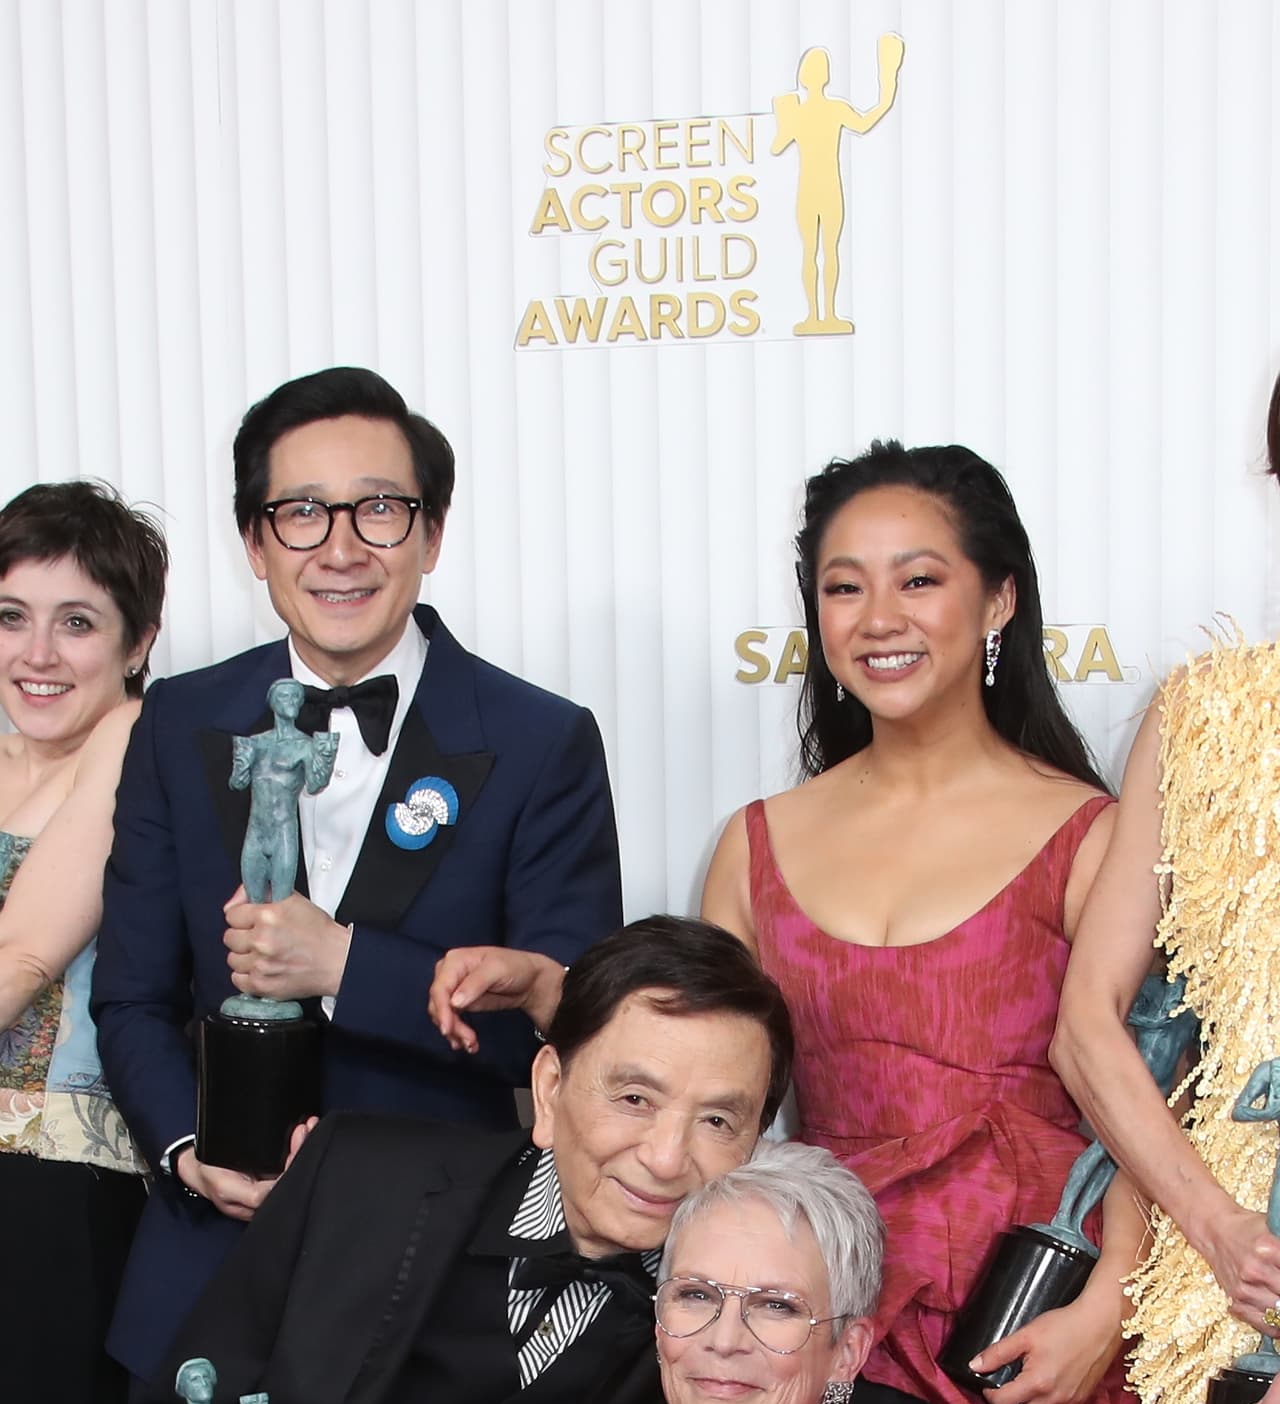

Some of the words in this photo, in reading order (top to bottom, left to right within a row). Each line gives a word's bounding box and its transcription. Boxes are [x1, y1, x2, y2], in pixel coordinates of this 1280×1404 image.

[543, 118, 754, 176] SCREEN
[529, 175, 759, 233] ACTORS
[588, 233, 757, 286] GUILD
[518, 289, 761, 345] AWARDS
